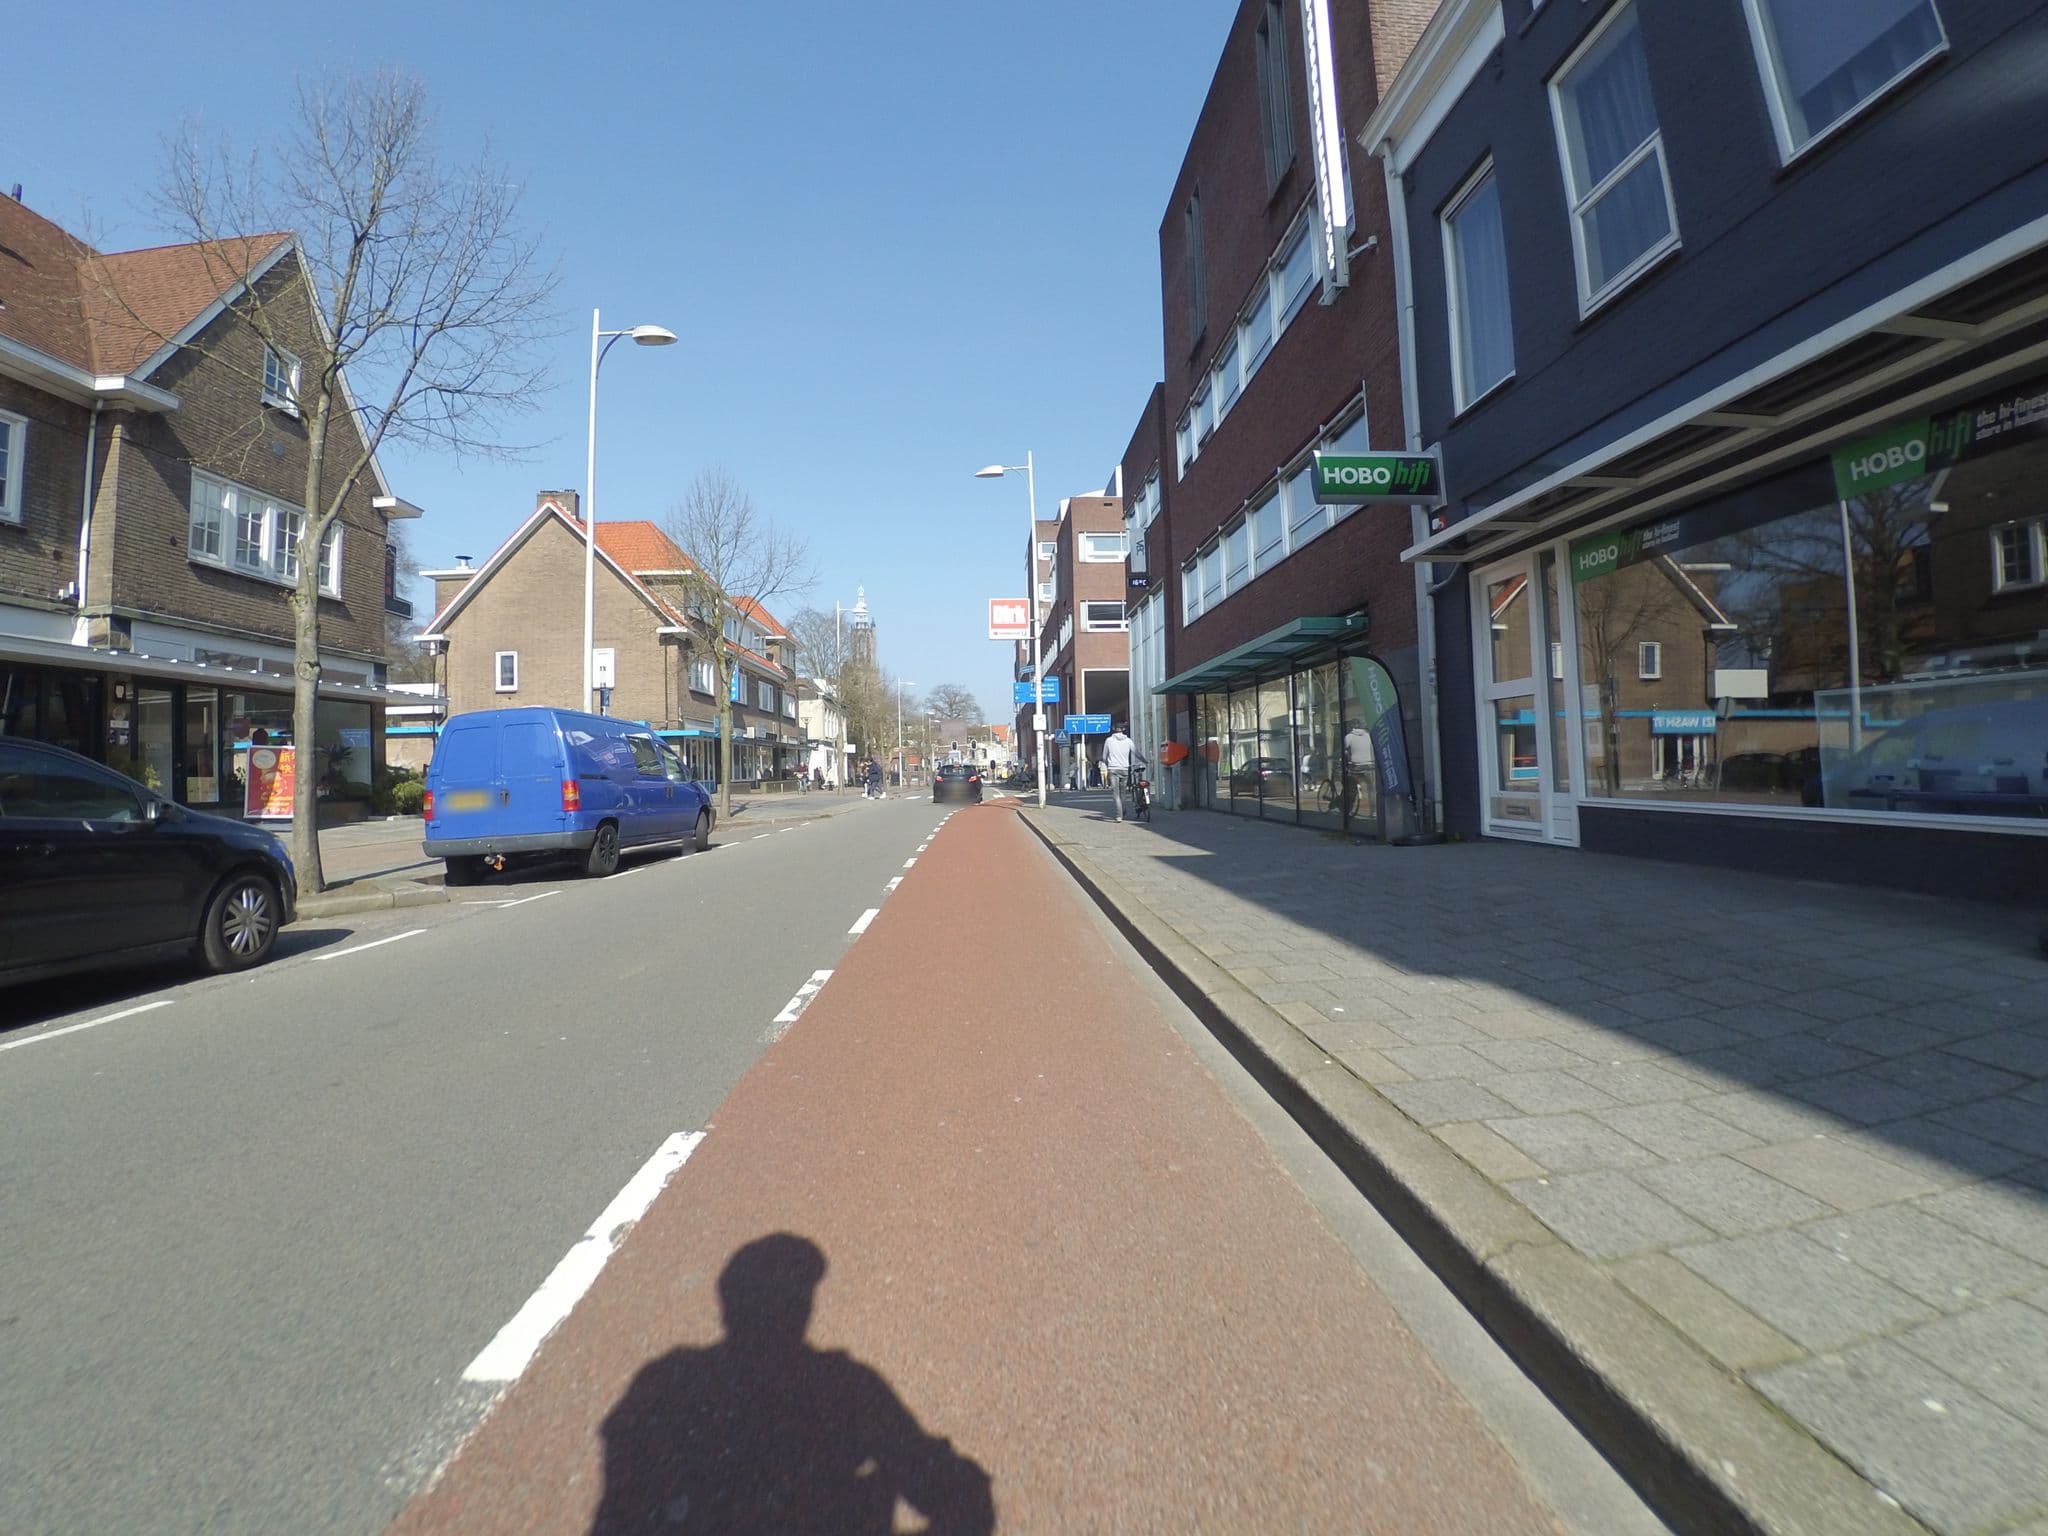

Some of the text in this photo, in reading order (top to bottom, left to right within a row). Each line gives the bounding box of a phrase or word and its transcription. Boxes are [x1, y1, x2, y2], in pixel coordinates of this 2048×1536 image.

[1850, 410, 1973, 481] HOBO hifi
[1323, 460, 1431, 494] HOBO hifi
[1579, 544, 1618, 570] HOBO
[1367, 666, 1384, 714] HOBO
